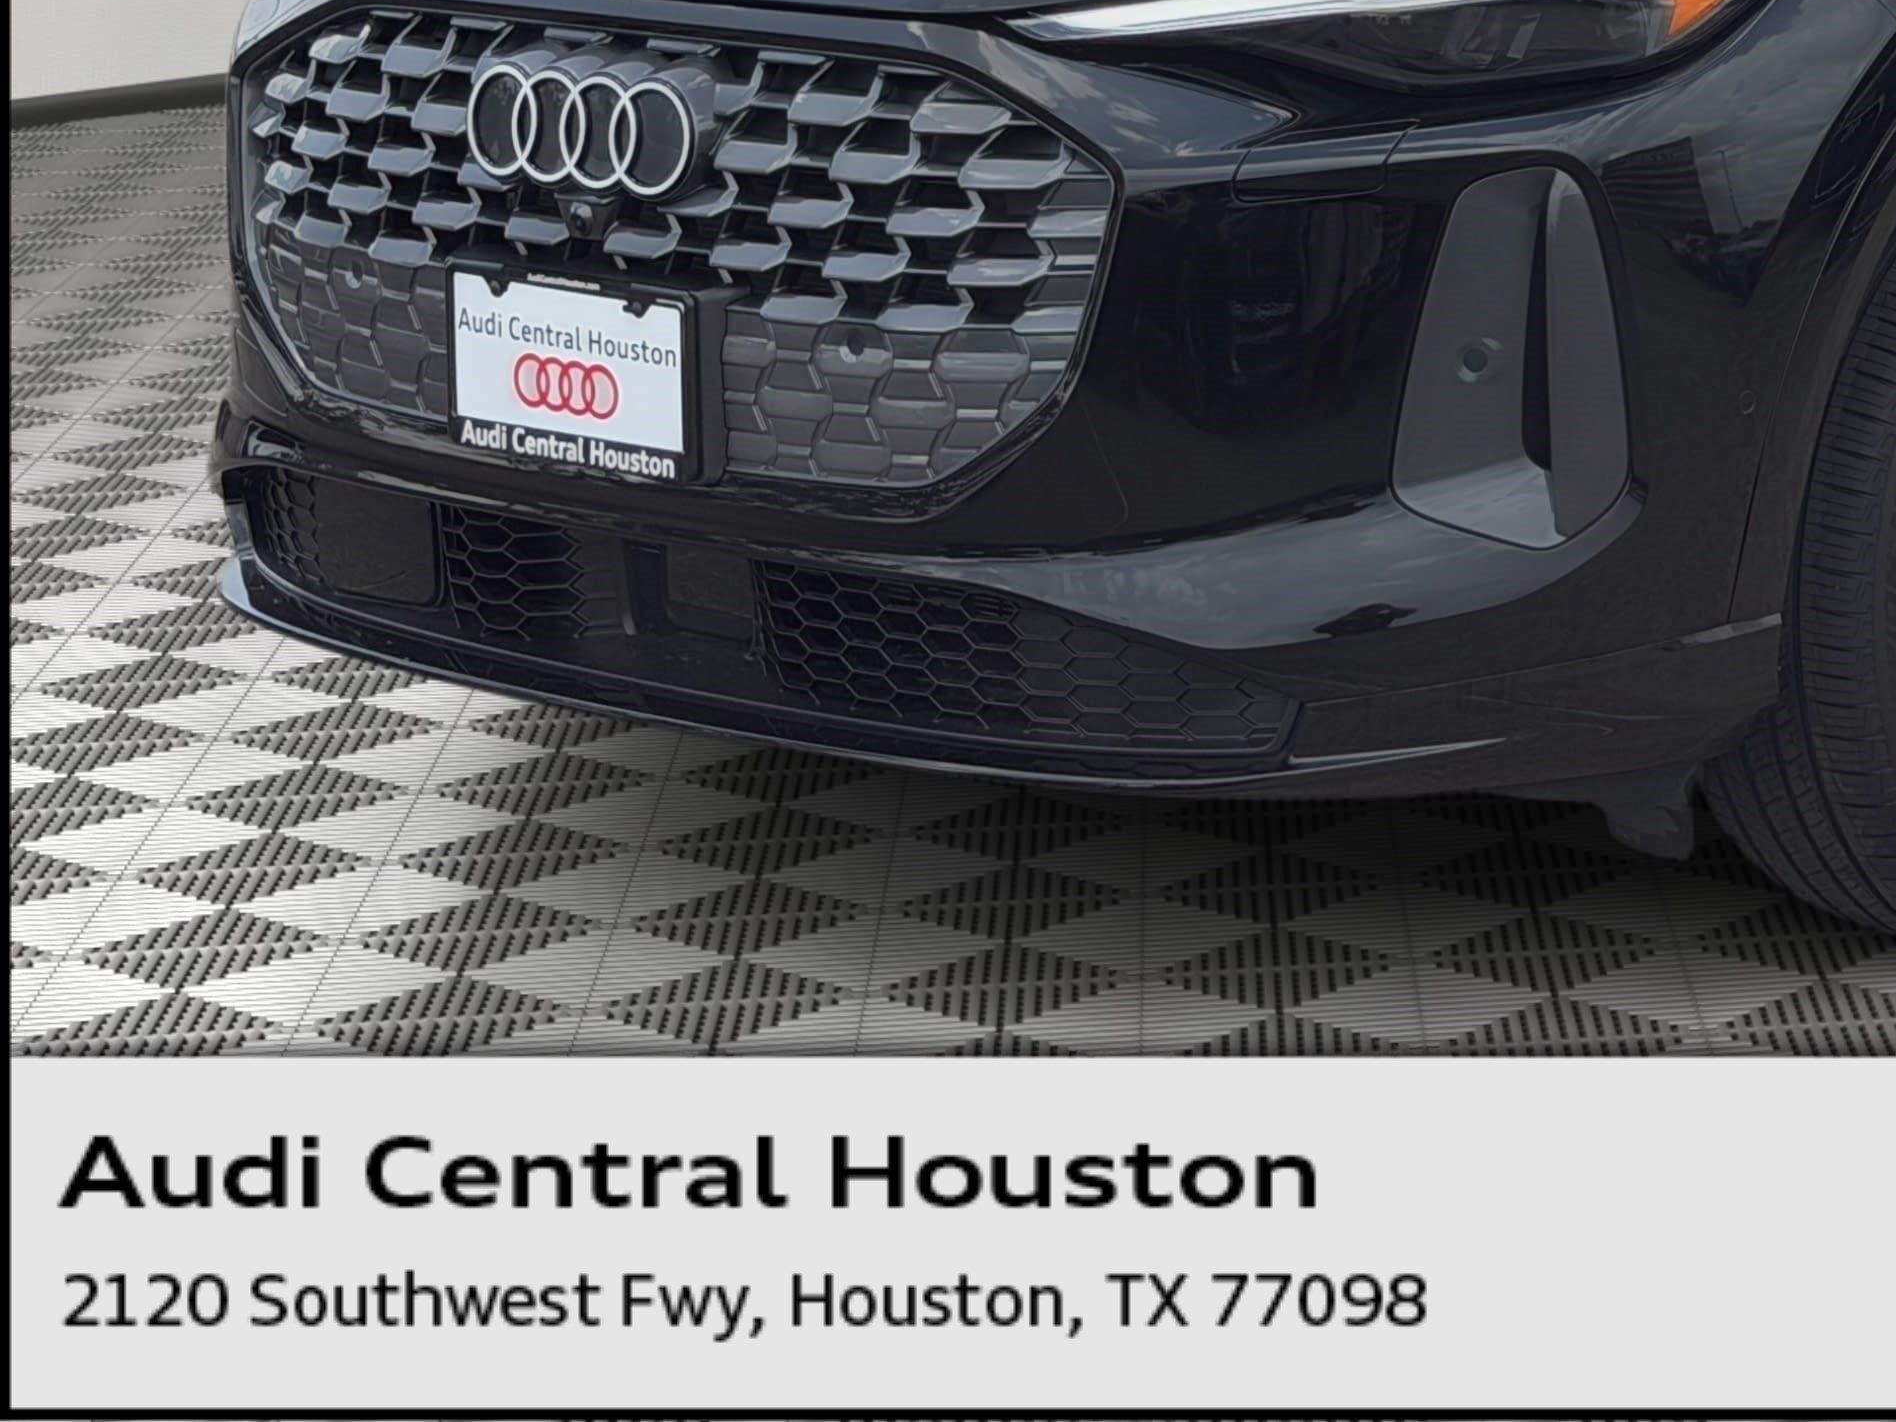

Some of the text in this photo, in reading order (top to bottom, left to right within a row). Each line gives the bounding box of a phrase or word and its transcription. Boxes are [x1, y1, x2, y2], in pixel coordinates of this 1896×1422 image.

[458, 307, 677, 368] Audi Central Houston
[461, 419, 675, 478] Audi Central Houston
